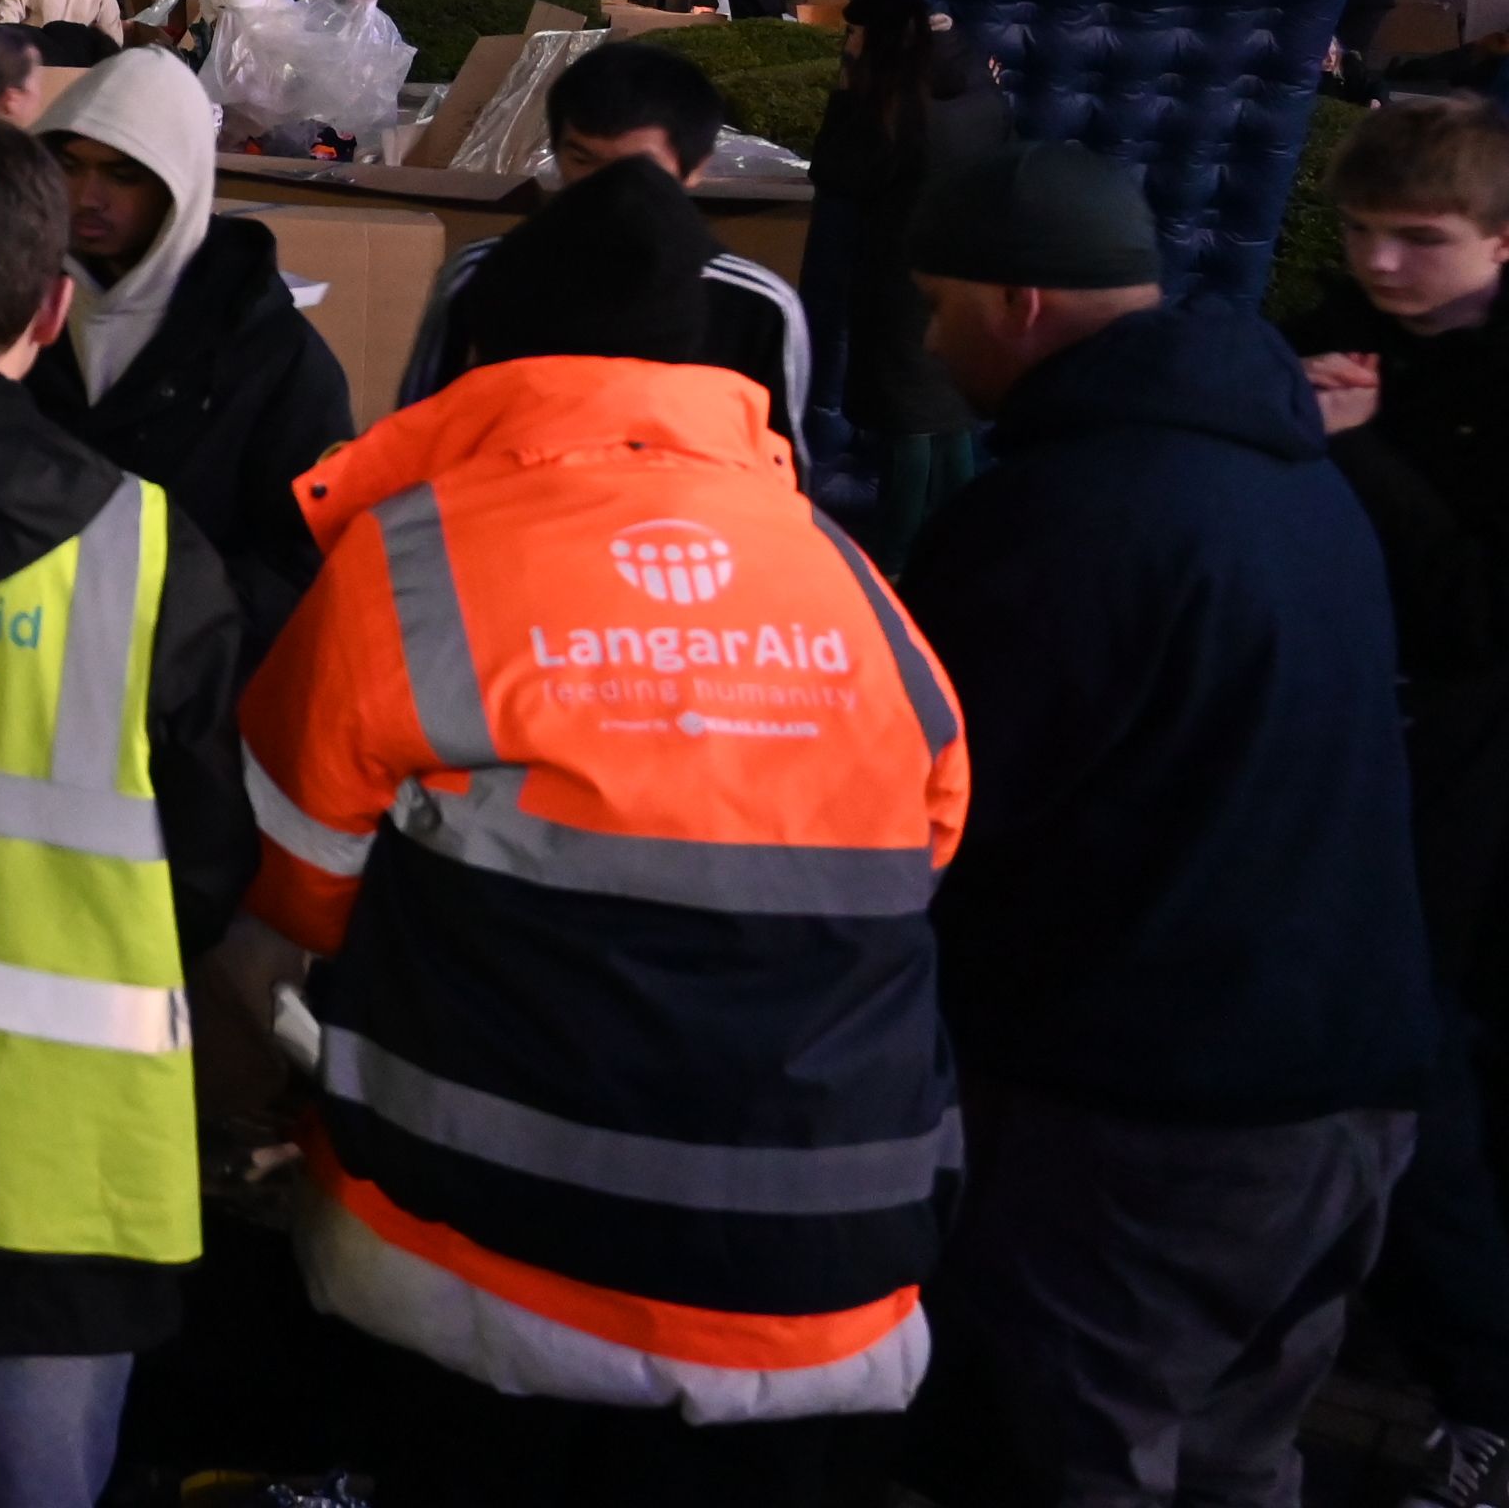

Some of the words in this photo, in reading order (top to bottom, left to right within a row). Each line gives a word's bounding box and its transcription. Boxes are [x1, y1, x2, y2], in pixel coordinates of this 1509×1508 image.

[530, 623, 849, 674] LangarAid
[542, 677, 680, 704] feeding
[692, 677, 857, 712] humanity
